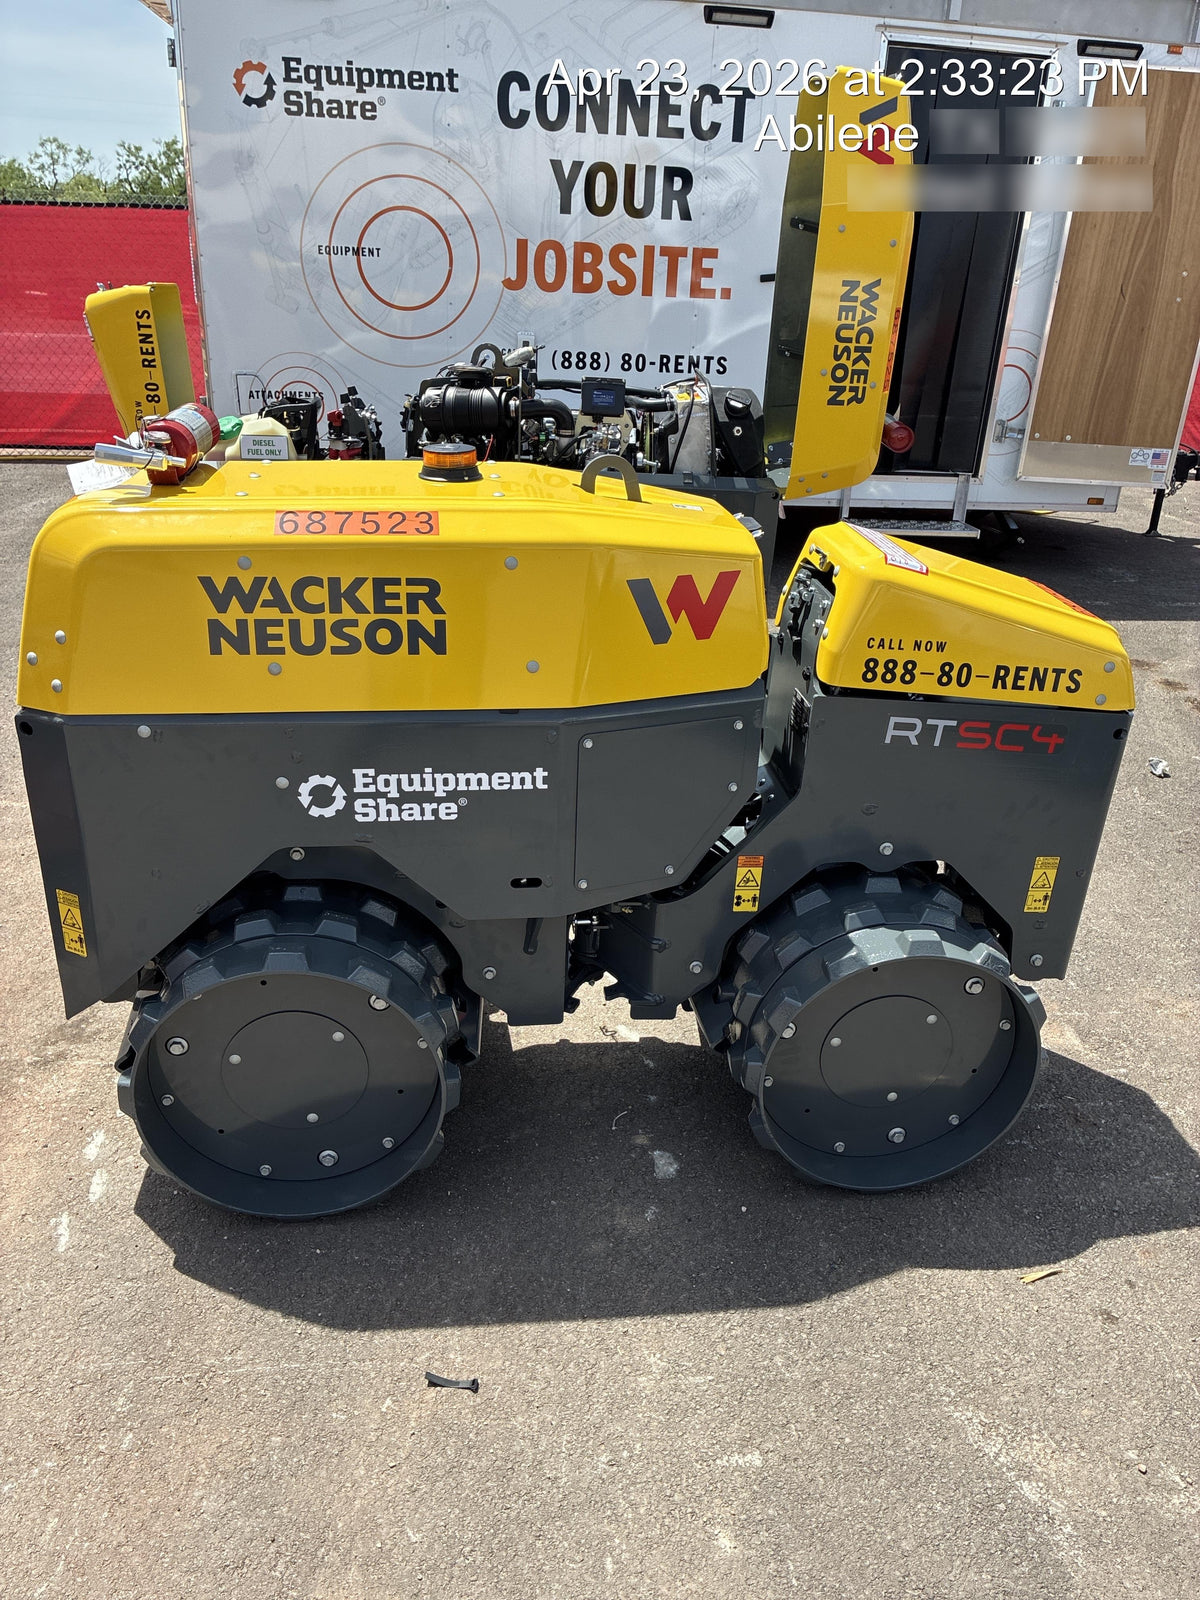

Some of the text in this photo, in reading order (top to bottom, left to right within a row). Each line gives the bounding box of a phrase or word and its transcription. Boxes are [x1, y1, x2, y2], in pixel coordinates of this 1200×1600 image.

[282, 56, 459, 93] Equipment
[497, 70, 755, 142] CONNECT
[549, 159, 693, 220] YOUR
[317, 245, 382, 258] EQUIPMENT
[501, 238, 732, 300] JOBSITE.
[827, 280, 861, 406] NEUSON
[846, 278, 882, 406] WACKER
[552, 349, 728, 375] (888) 80-RENTS
[247, 448, 282, 457] FUEL ONLY
[252, 439, 276, 447] DIESEL
[279, 510, 435, 535] 687523
[197, 576, 447, 615] WACKER
[207, 618, 448, 656] NEUSON
[866, 637, 948, 653] CALL NOW
[861, 657, 1084, 694] 888-80-RENTS
[352, 767, 549, 798] Equipment
